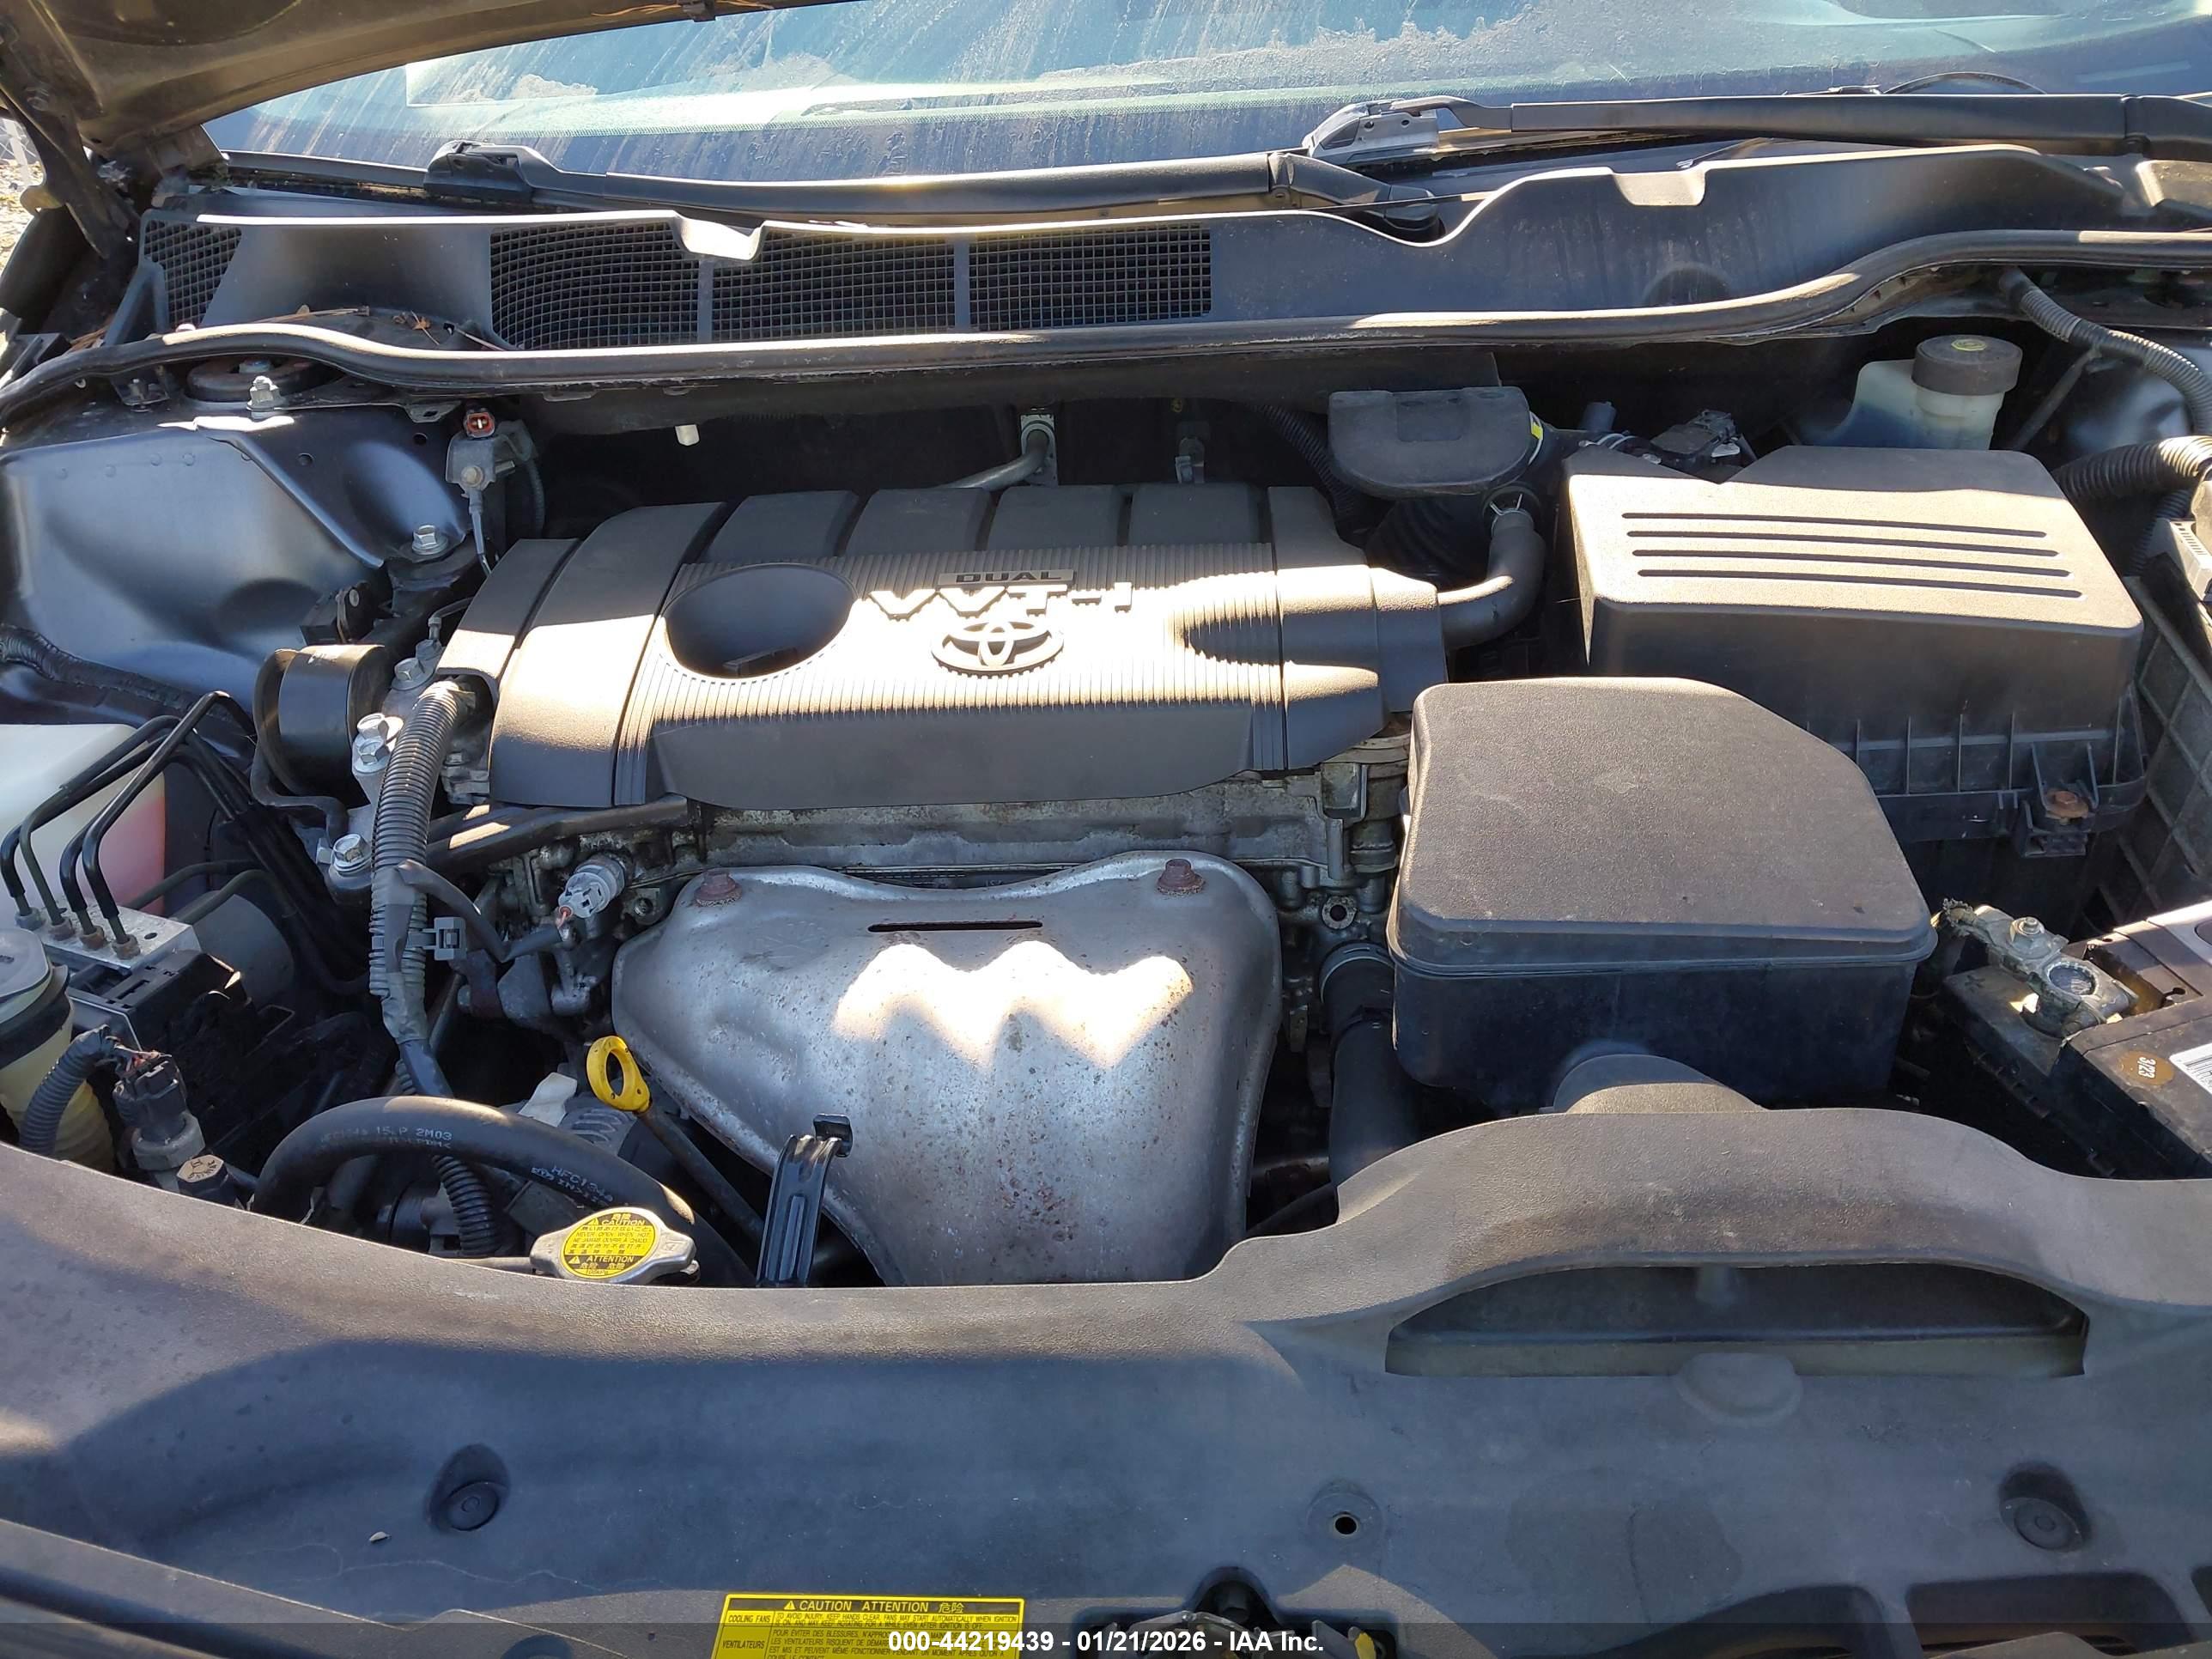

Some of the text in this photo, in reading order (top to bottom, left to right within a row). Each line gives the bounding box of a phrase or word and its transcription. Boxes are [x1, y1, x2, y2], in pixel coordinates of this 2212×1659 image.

[956, 570, 1062, 583] DUAL
[2136, 1056, 2156, 1079] 3/23
[799, 1600, 964, 1614] CAUTION ATTENTION 危险
[727, 1614, 771, 1623] COOLING FANS
[722, 1640, 766, 1650] VENTILATEURS
[784, 1638, 824, 1646] VENTILATEURS
